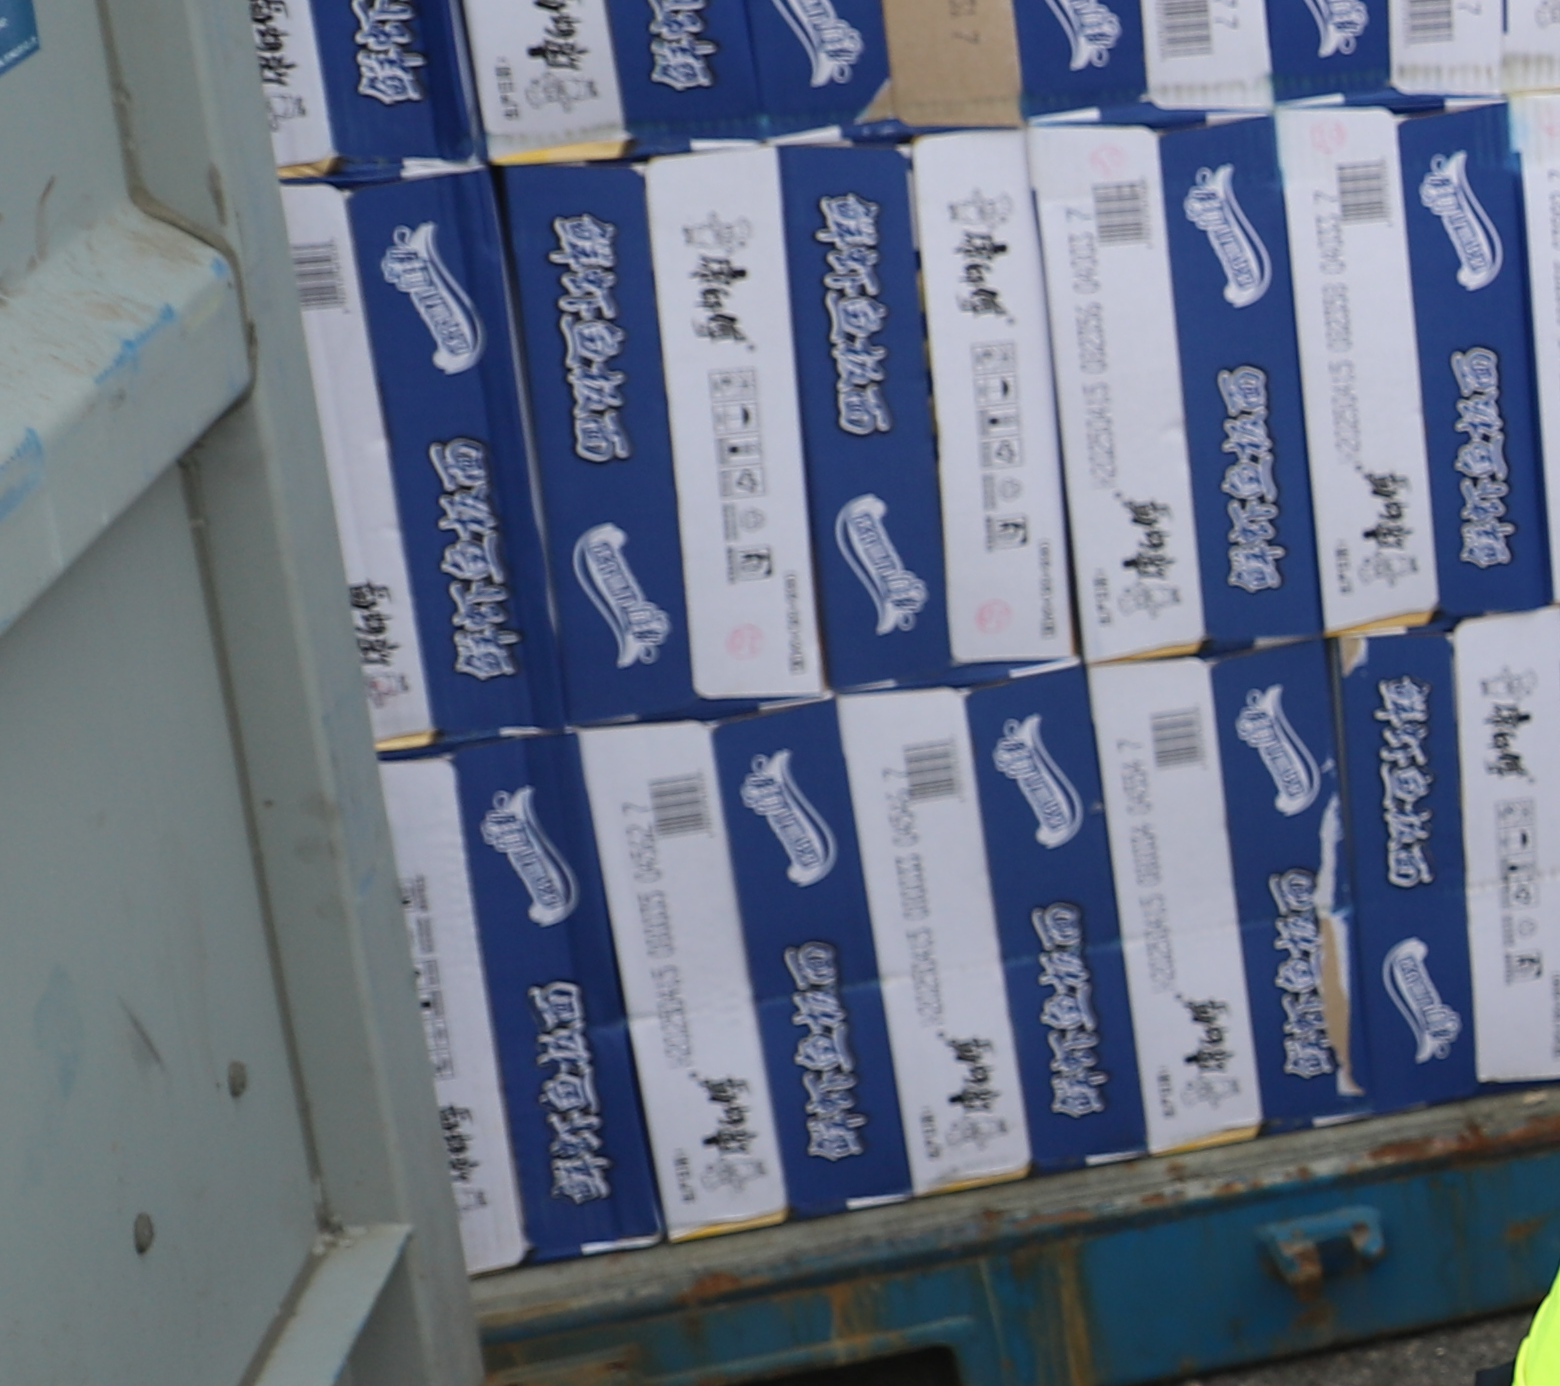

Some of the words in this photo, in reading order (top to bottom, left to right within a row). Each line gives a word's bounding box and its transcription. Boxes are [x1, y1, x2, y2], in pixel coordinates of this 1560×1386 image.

[550, 216, 627, 461] 鲜虾鱼板面
[817, 195, 888, 434] 鲜虾鱼板面
[430, 439, 520, 680] 鲜虾鱼板面
[1218, 367, 1284, 591] 鲜虾鱼板面
[1452, 348, 1513, 566] 鲜虾鱼板面
[1376, 678, 1431, 886] 鲜虾鱼板面
[784, 941, 868, 1161] 鲜虾鱼板面
[1031, 902, 1107, 1119] 鲜虾鱼板面
[1269, 869, 1333, 1078] 鲜虾鱼板面
